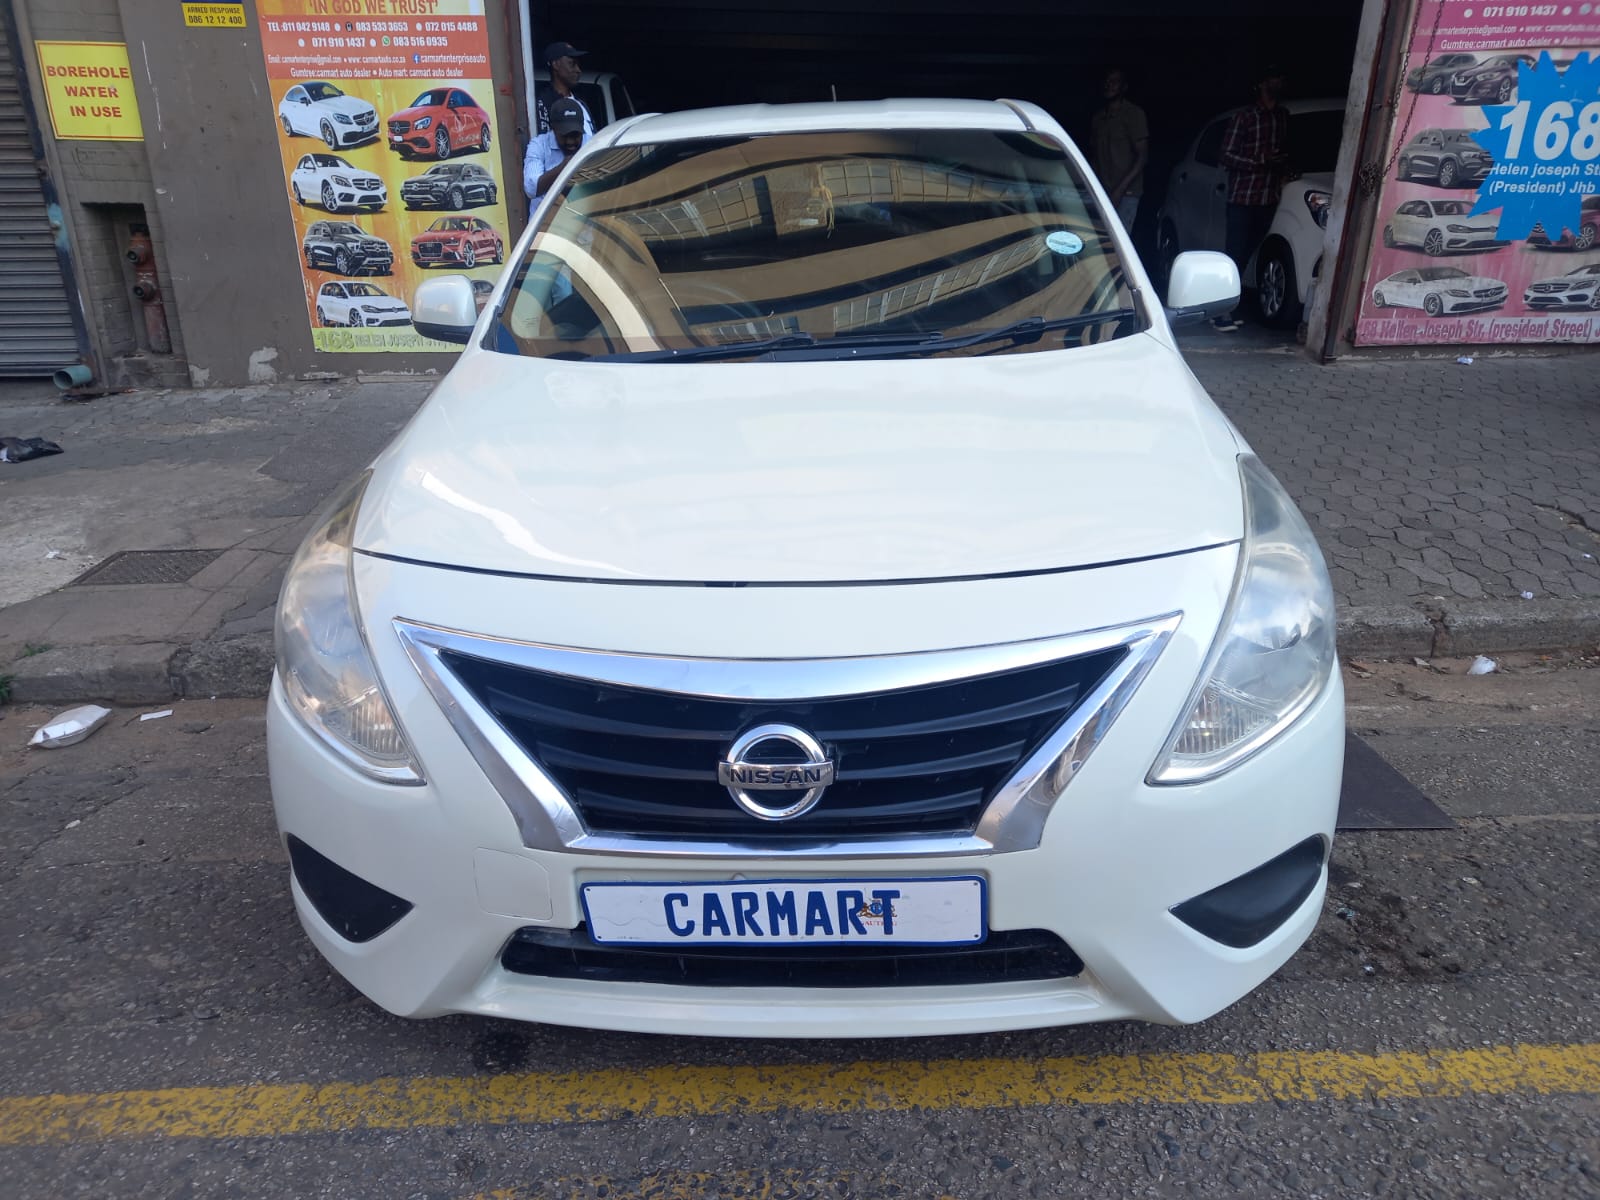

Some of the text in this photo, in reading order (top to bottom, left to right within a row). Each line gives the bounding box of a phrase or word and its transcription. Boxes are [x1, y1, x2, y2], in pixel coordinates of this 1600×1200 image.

[332, 0, 361, 14] GOD
[365, 0, 387, 14] WE
[1482, 5, 1558, 17] 071 910 1437
[188, 15, 242, 24] 086 12 12 400
[296, 22, 311, 32] 042
[312, 22, 331, 32] 9148
[355, 22, 370, 32] 083
[371, 22, 387, 32] 533
[388, 22, 408, 32] 3653
[425, 22, 441, 32] 072
[441, 22, 456, 32] 015
[457, 22, 478, 32] 4488
[311, 36, 448, 48] 071 910 1437 083 516 0935
[1508, 37, 1526, 47] auto
[1527, 37, 1552, 46] dealer
[420, 53, 487, 65] carmartenterpriseauto
[46, 65, 130, 79] BOREHOLE
[339, 69, 352, 77] auto
[353, 68, 371, 77] dealer
[378, 67, 392, 77] Auto
[409, 68, 431, 77] carmart
[432, 68, 445, 77] auto
[446, 67, 464, 77] dealer
[64, 85, 119, 98] WATER
[69, 105, 122, 118] IN USE
[1499, 100, 1600, 161] 168
[1490, 163, 1600, 179] Helen joseph St
[1489, 180, 1596, 196] (President) Jhb
[1418, 320, 1463, 340] Joseph
[1488, 318, 1550, 342] (president
[1551, 318, 1593, 342] Street)
[315, 330, 354, 349] 168
[730, 768, 820, 784] NISSAN
[663, 889, 901, 937] CARMART
